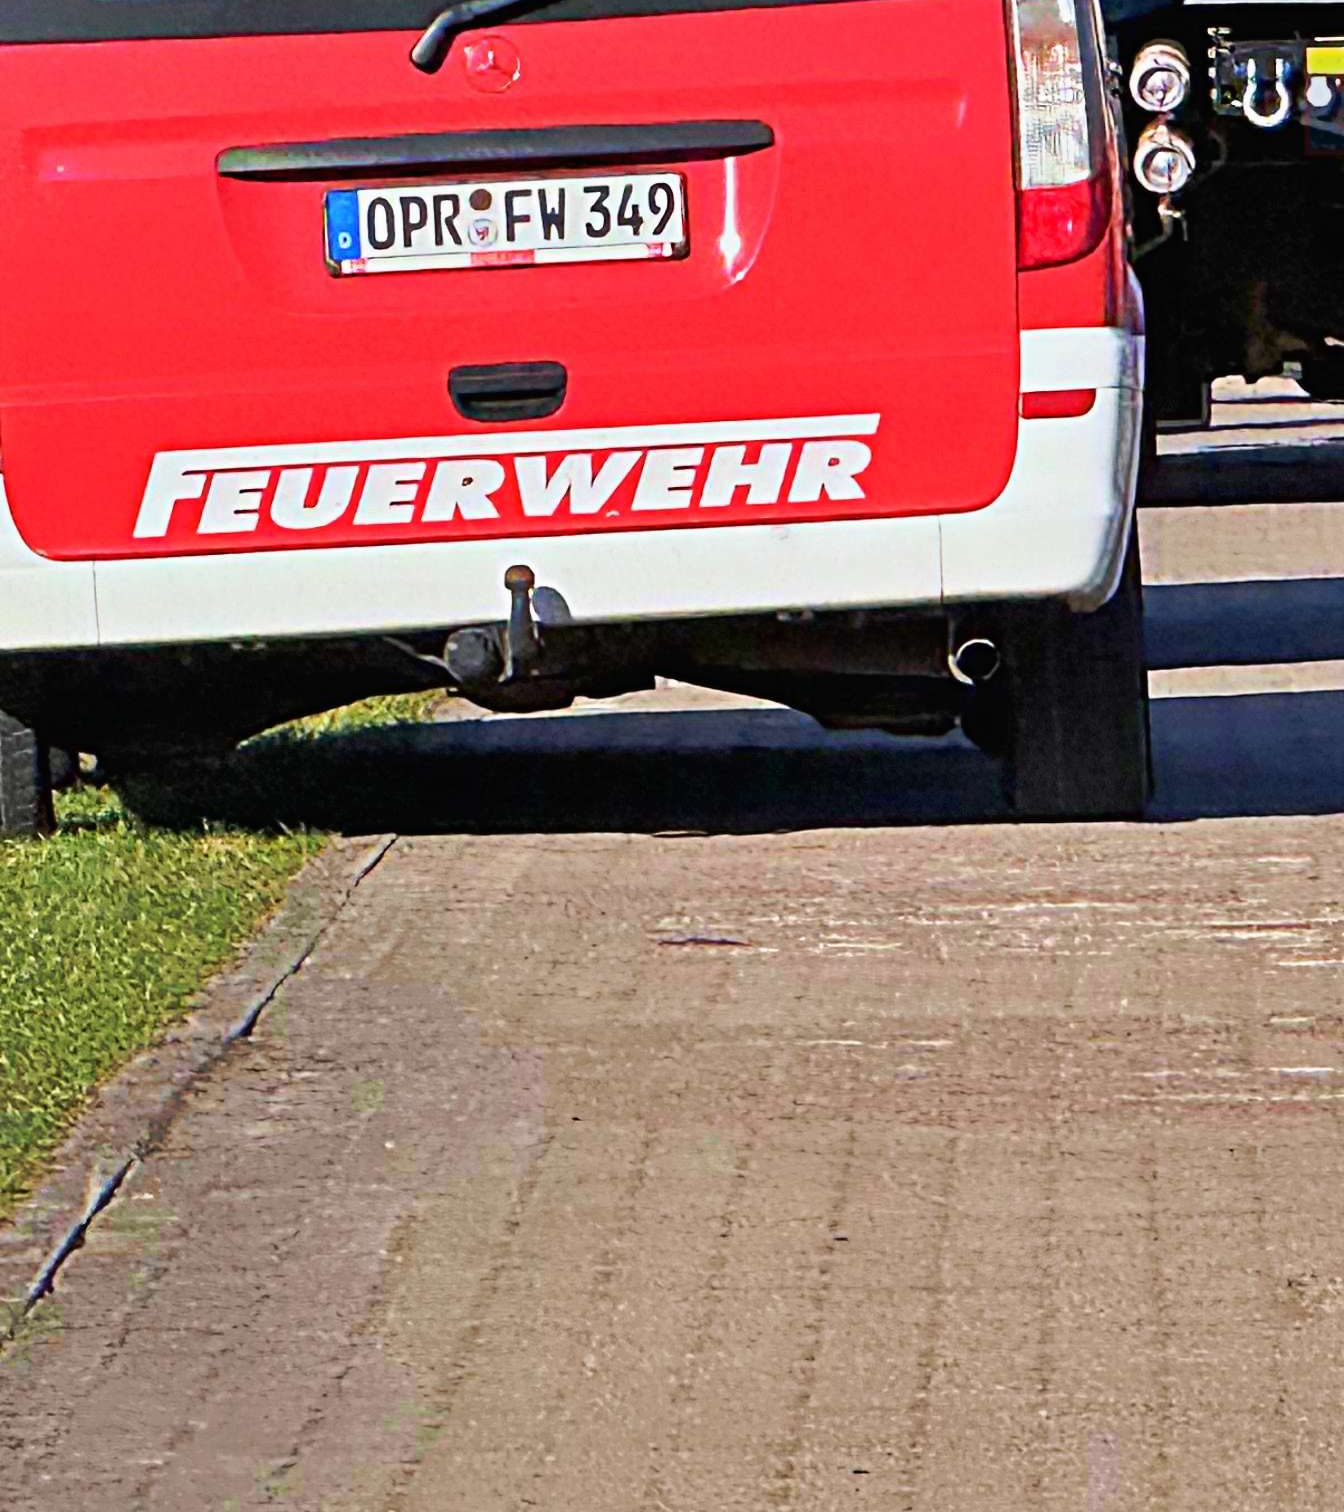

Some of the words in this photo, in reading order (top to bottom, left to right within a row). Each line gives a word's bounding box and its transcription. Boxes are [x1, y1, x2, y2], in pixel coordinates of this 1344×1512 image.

[366, 193, 463, 251] OPR
[503, 187, 566, 243] FW
[583, 181, 676, 239] 349
[132, 412, 881, 539] FEUERWEHR
